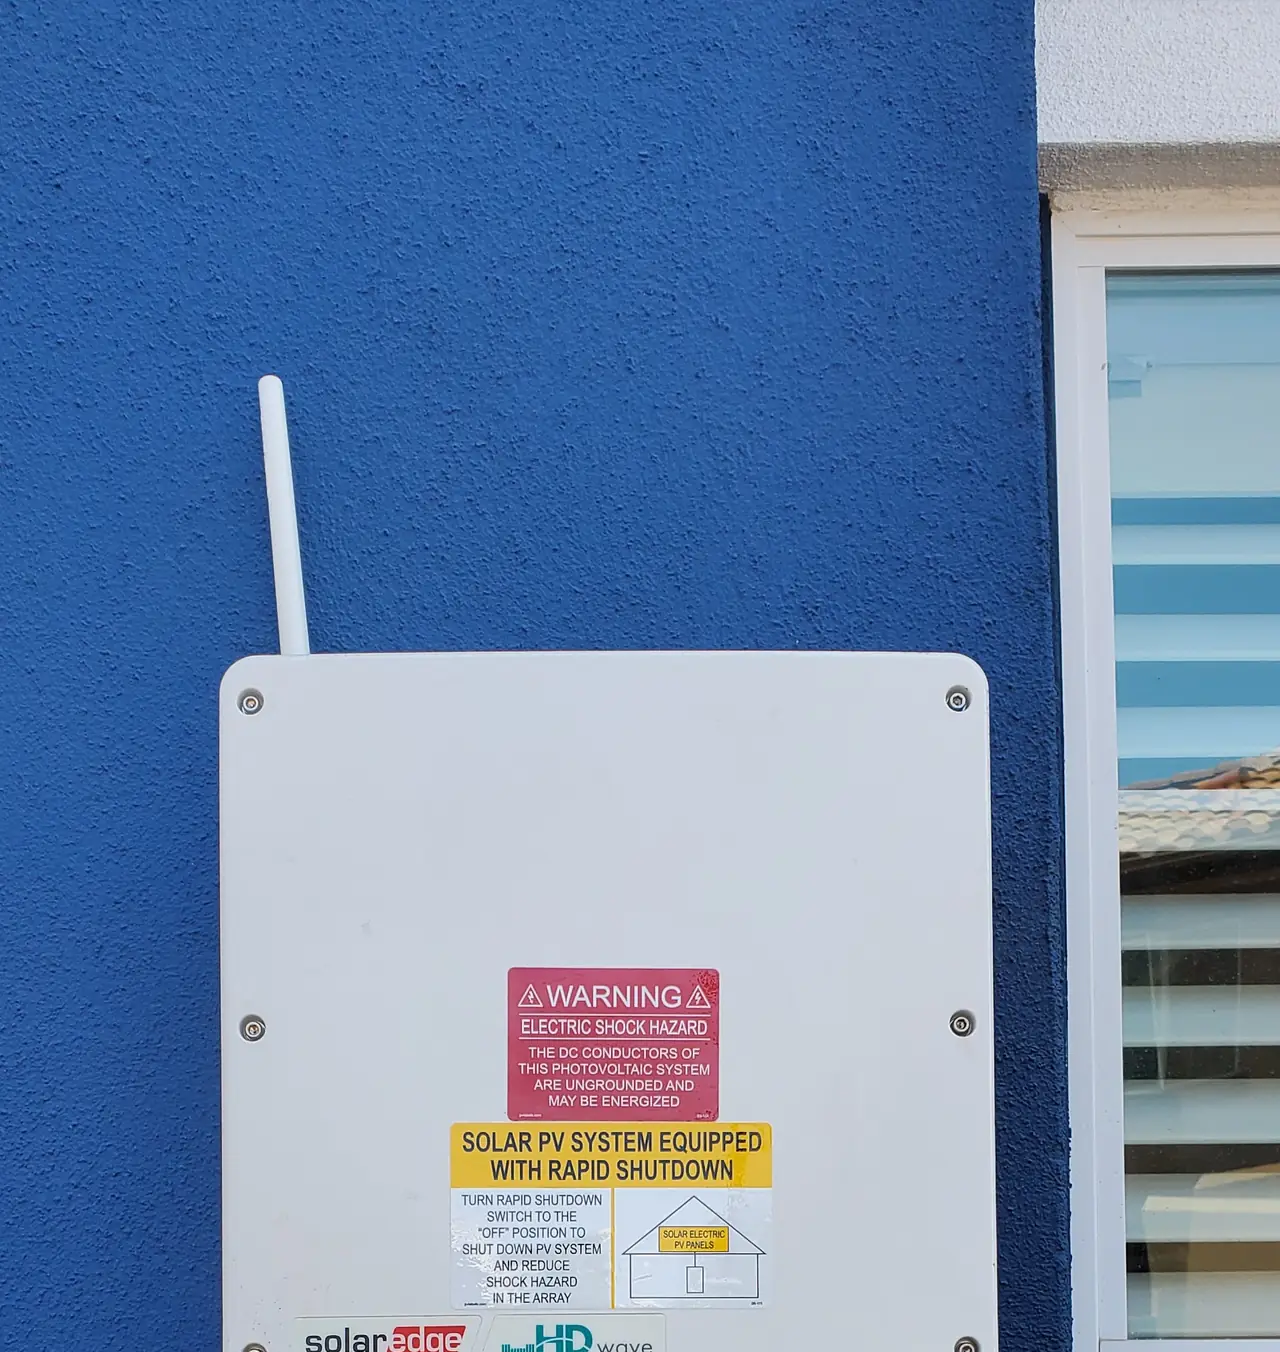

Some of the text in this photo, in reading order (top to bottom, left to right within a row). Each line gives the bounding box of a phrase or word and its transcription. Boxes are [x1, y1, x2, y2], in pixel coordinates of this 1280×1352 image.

[546, 984, 682, 1008] WARNING
[521, 1018, 708, 1036] ELECTRIC SHOCK HAZARD
[529, 1047, 700, 1060] THE DC CONDUCTORS OF
[518, 1063, 710, 1076] THIS PHOTOVOLTAIC SYSTEM
[534, 1079, 694, 1092] ARE UNGROUNDED AND
[548, 1095, 680, 1108] MAY BE ENERGIZED
[462, 1131, 762, 1154] SOLAR PV SYSTEM EQUIPPED
[490, 1160, 733, 1181] WITH RAPID SHUTDOWN
[462, 1194, 602, 1206] TURN RAPID SHUTDOWN
[487, 1210, 576, 1222] SWITCH TO THE
[512, 1226, 566, 1238] POSITION
[570, 1226, 586, 1238] TO
[663, 1230, 726, 1238] SOLAR ELECTRIC
[462, 1243, 602, 1255] SHUT DOWN PV SYSTEM
[674, 1240, 714, 1250] PV PANELS
[494, 1260, 570, 1272] AND REDUCE
[486, 1276, 578, 1288] SHOCK HAZARD
[493, 1292, 572, 1304] IN THE ARRAY
